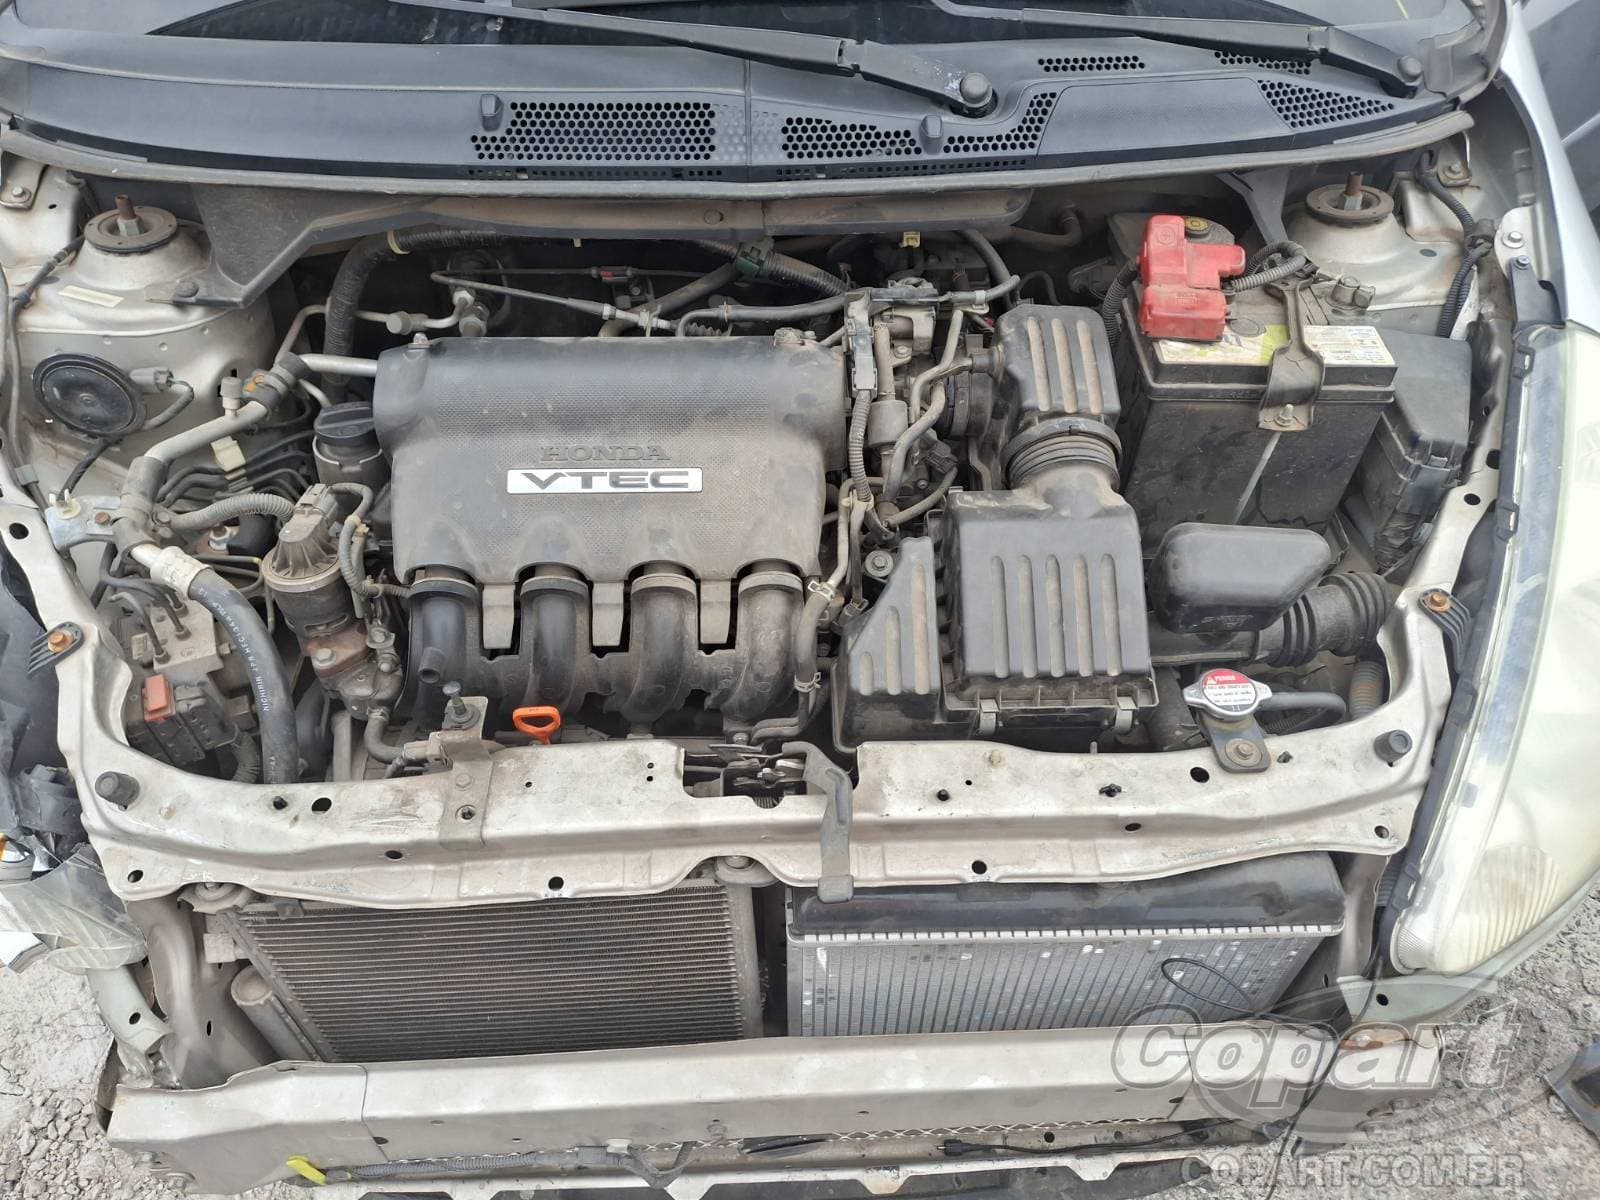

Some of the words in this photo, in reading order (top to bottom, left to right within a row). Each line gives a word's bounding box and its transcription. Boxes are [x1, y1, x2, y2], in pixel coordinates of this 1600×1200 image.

[541, 445, 671, 462] HONDA
[521, 470, 689, 490] VTEC
[256, 675, 269, 711] NICHIRIN
